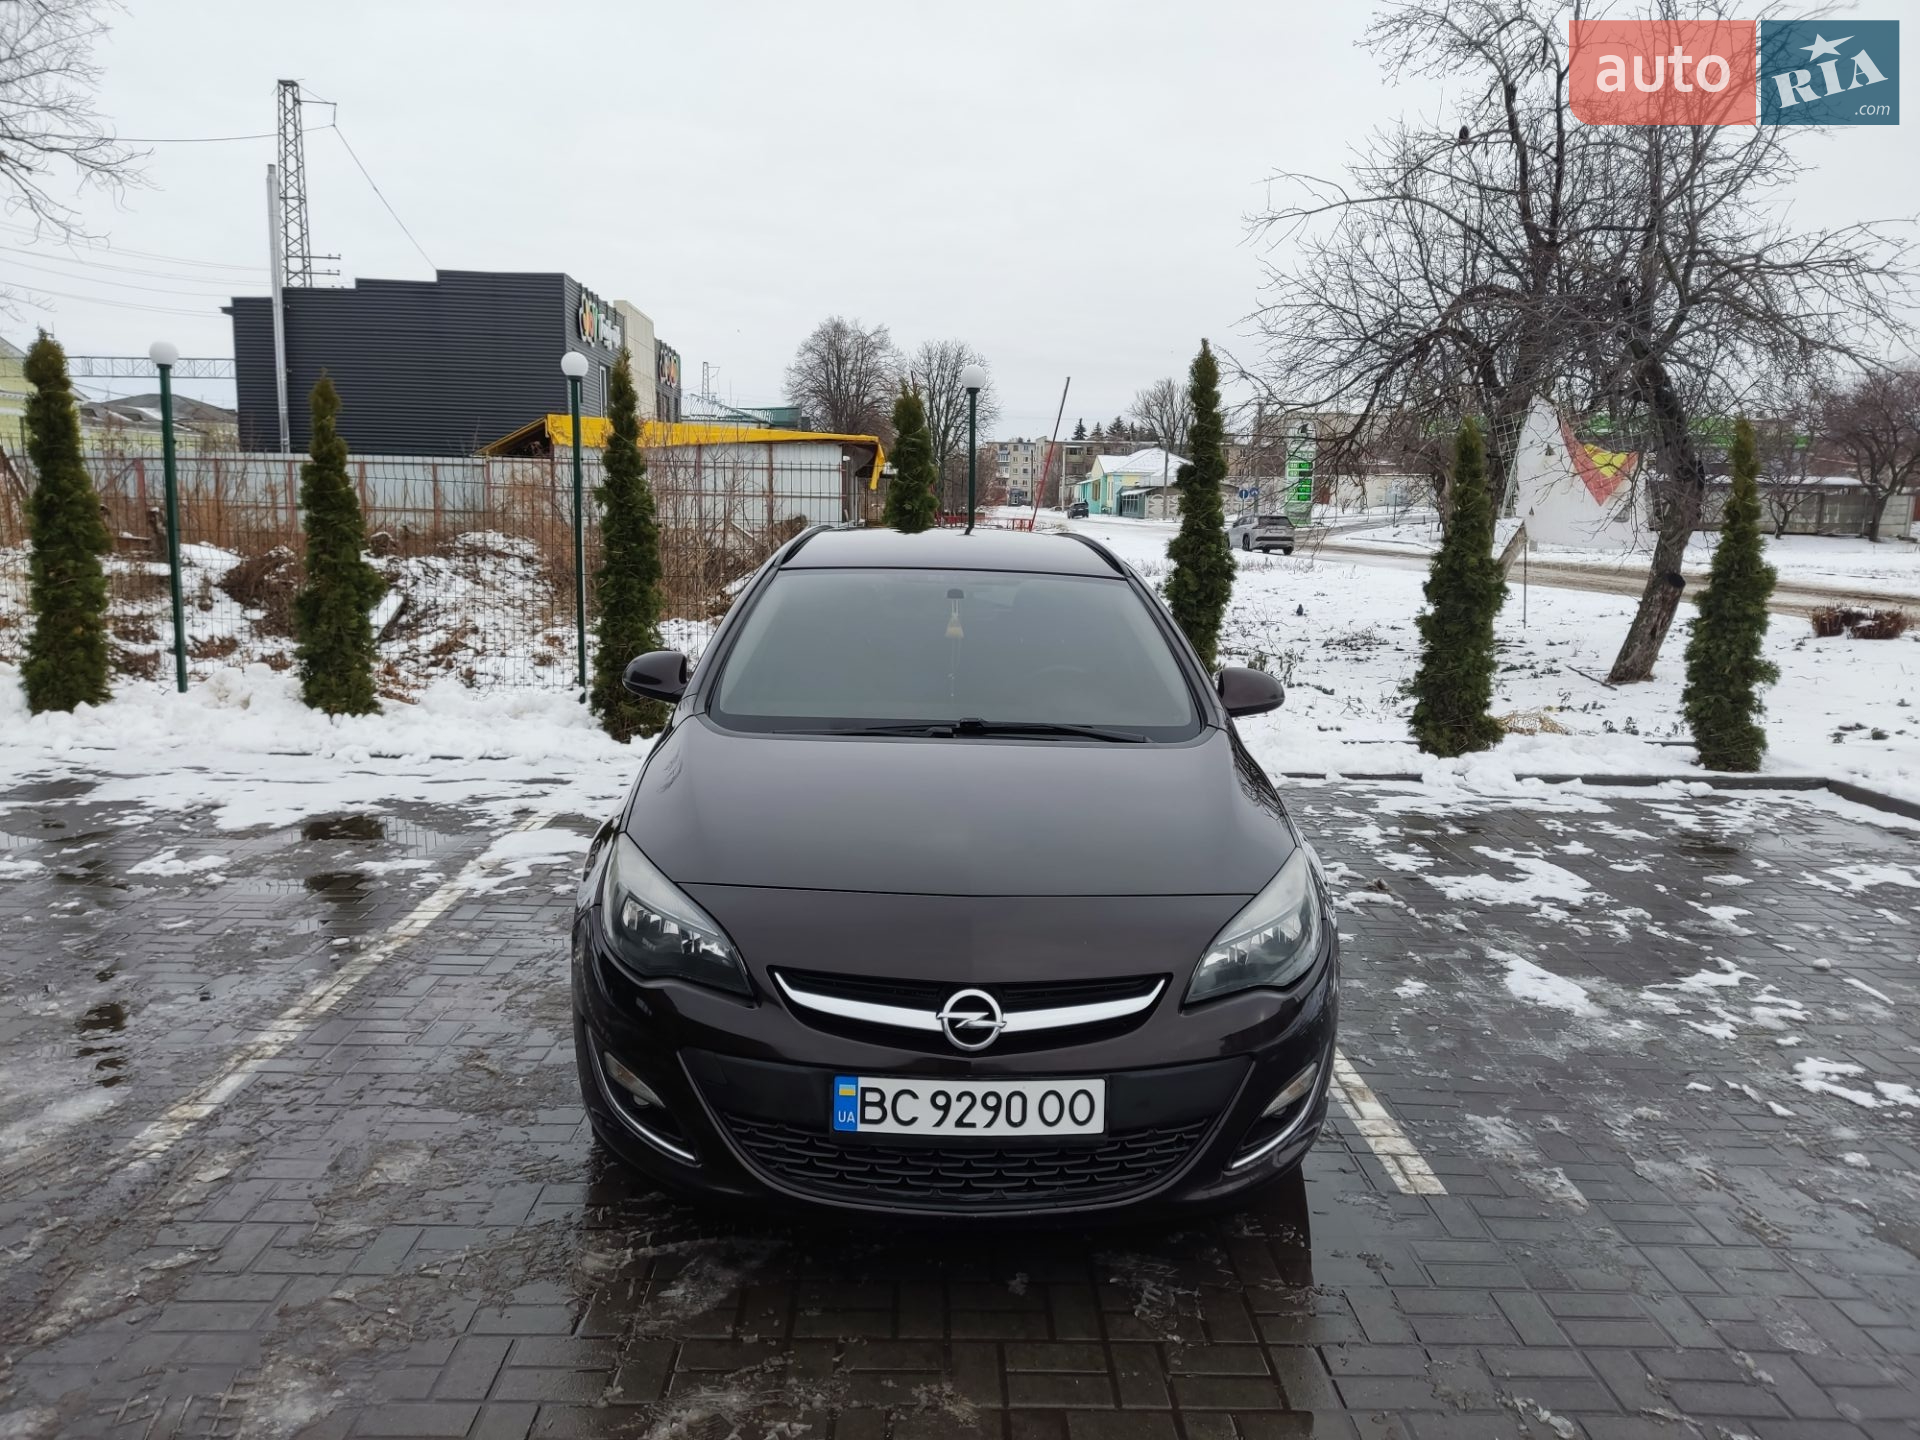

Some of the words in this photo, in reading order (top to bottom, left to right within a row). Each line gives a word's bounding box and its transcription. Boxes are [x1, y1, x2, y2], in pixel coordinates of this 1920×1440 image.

[838, 1111, 856, 1124] UA
[860, 1086, 919, 1127] BC
[930, 1089, 1028, 1129] 9290
